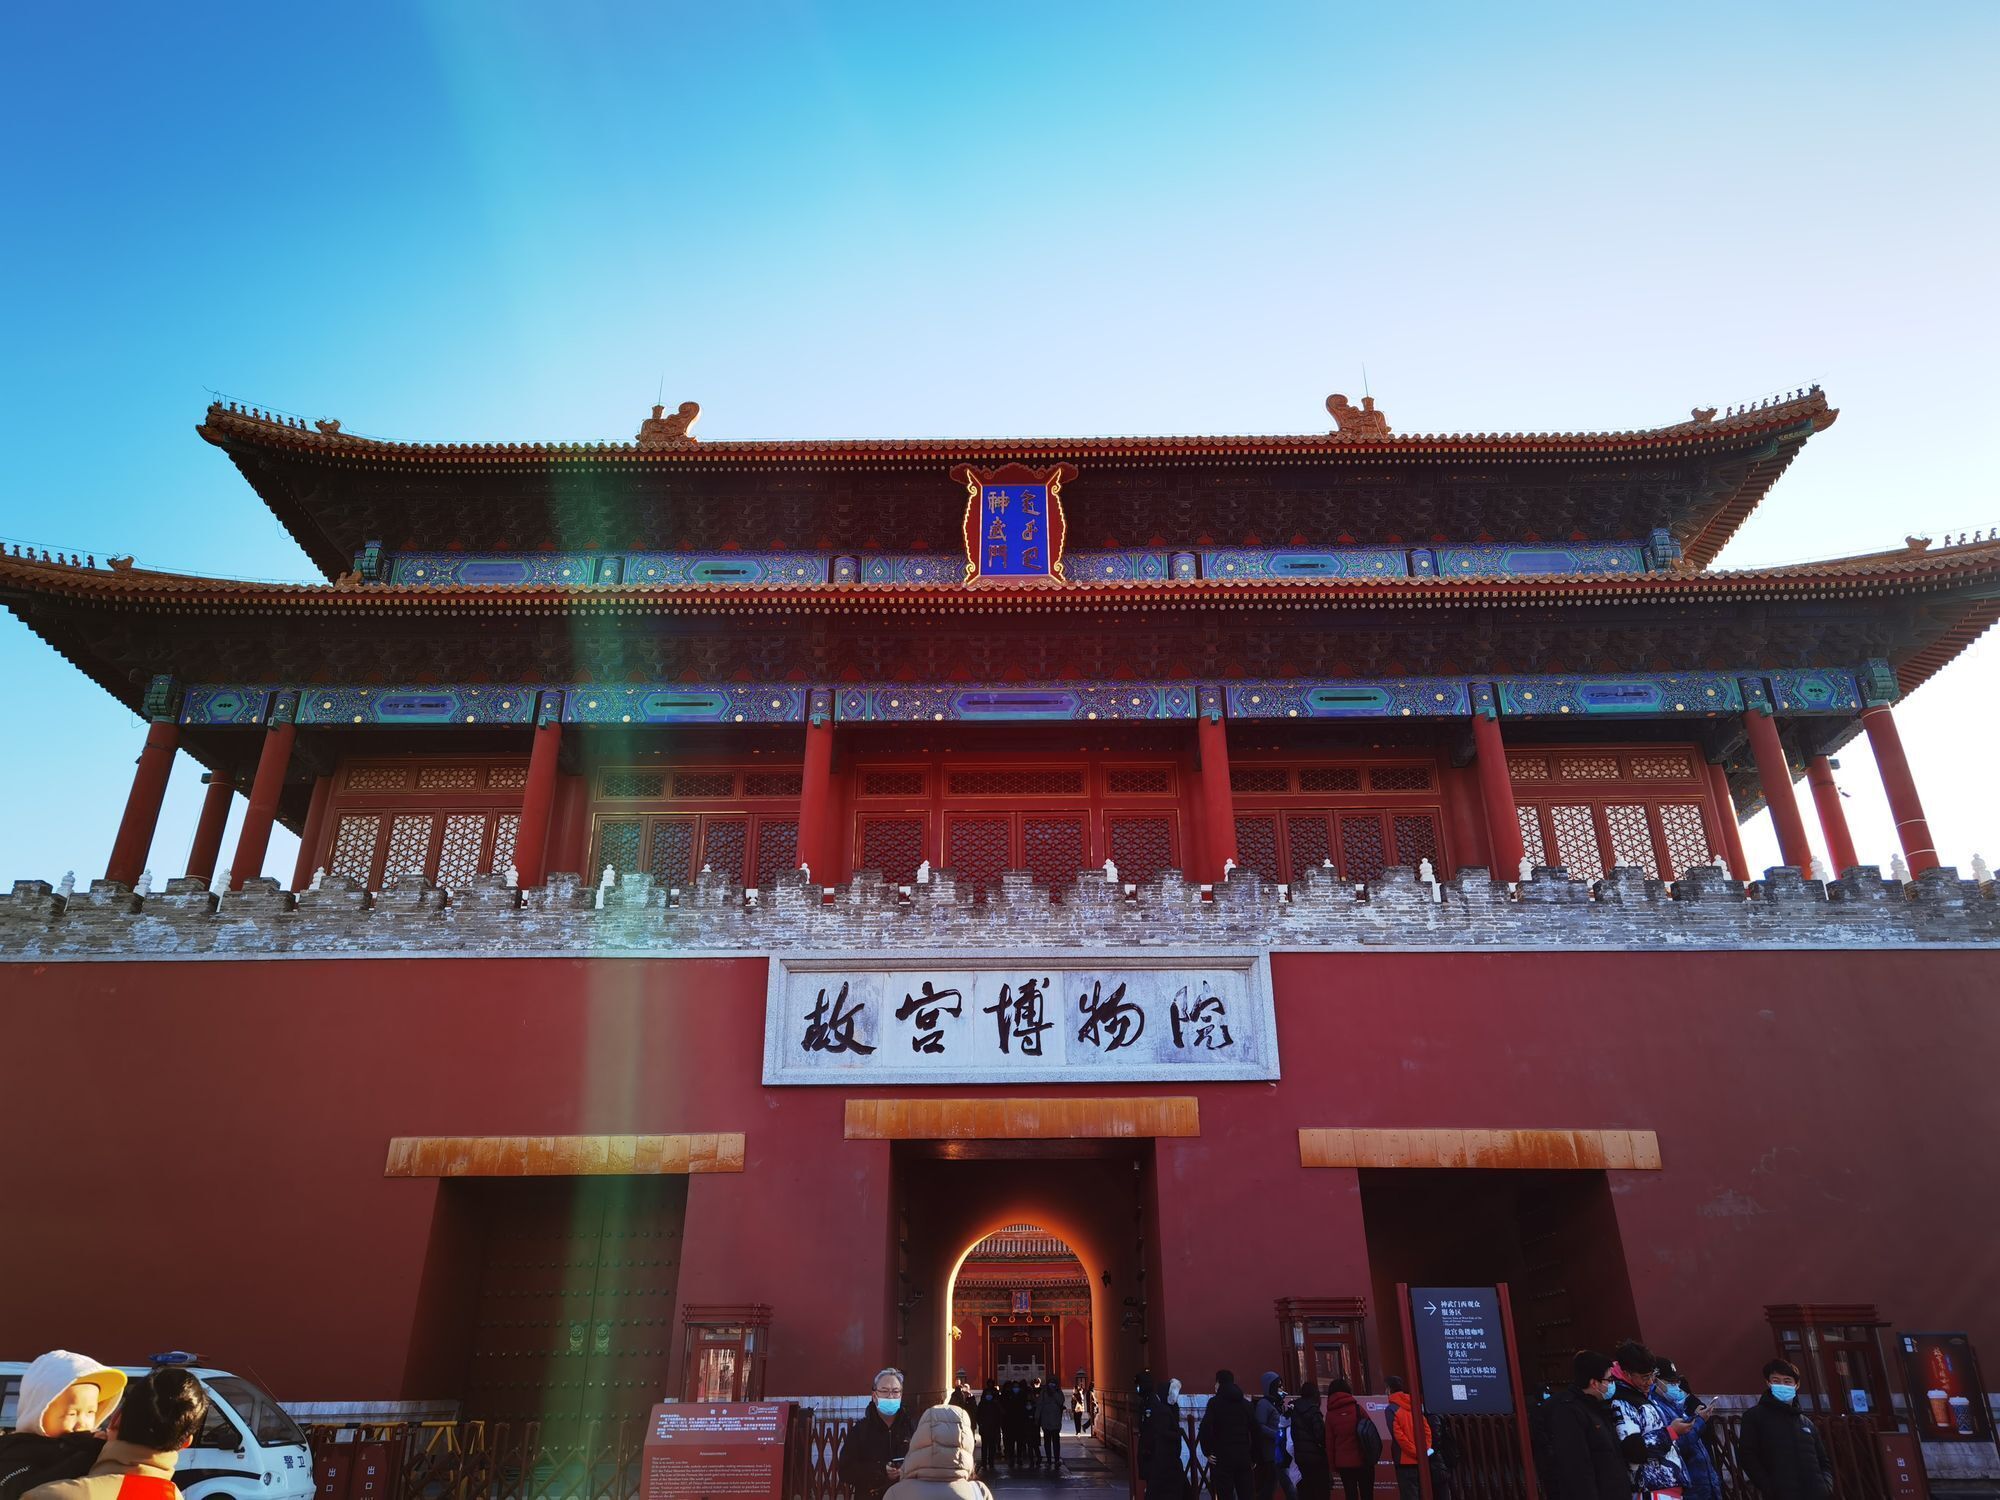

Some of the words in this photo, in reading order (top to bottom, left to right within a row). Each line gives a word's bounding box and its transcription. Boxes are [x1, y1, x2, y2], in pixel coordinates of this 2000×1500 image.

[800, 977, 1234, 1056] 故宫博物院
